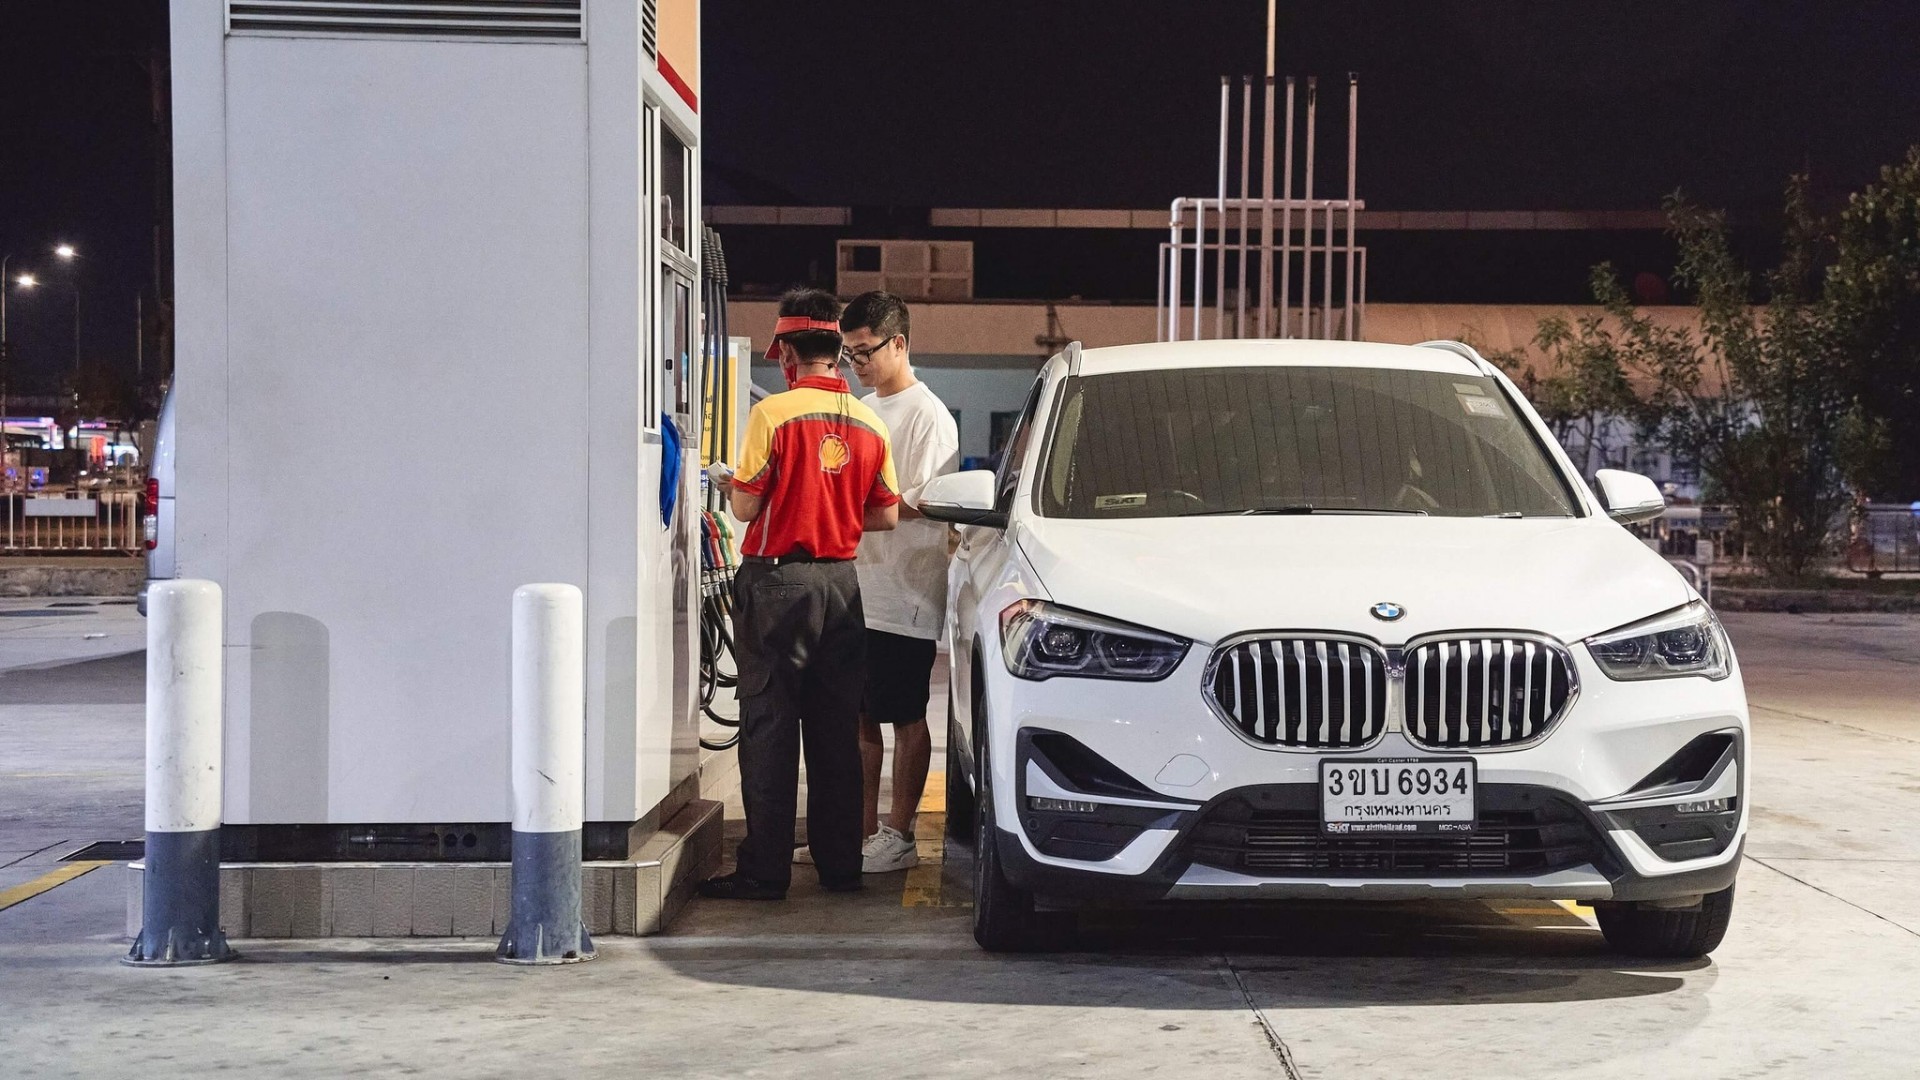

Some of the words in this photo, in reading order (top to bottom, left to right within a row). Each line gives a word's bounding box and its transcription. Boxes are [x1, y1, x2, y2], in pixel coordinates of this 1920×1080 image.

[1329, 768, 1389, 795] 3ขบ
[1398, 768, 1467, 795] 6934
[1345, 804, 1451, 820] กรุงเทพมหานคร
